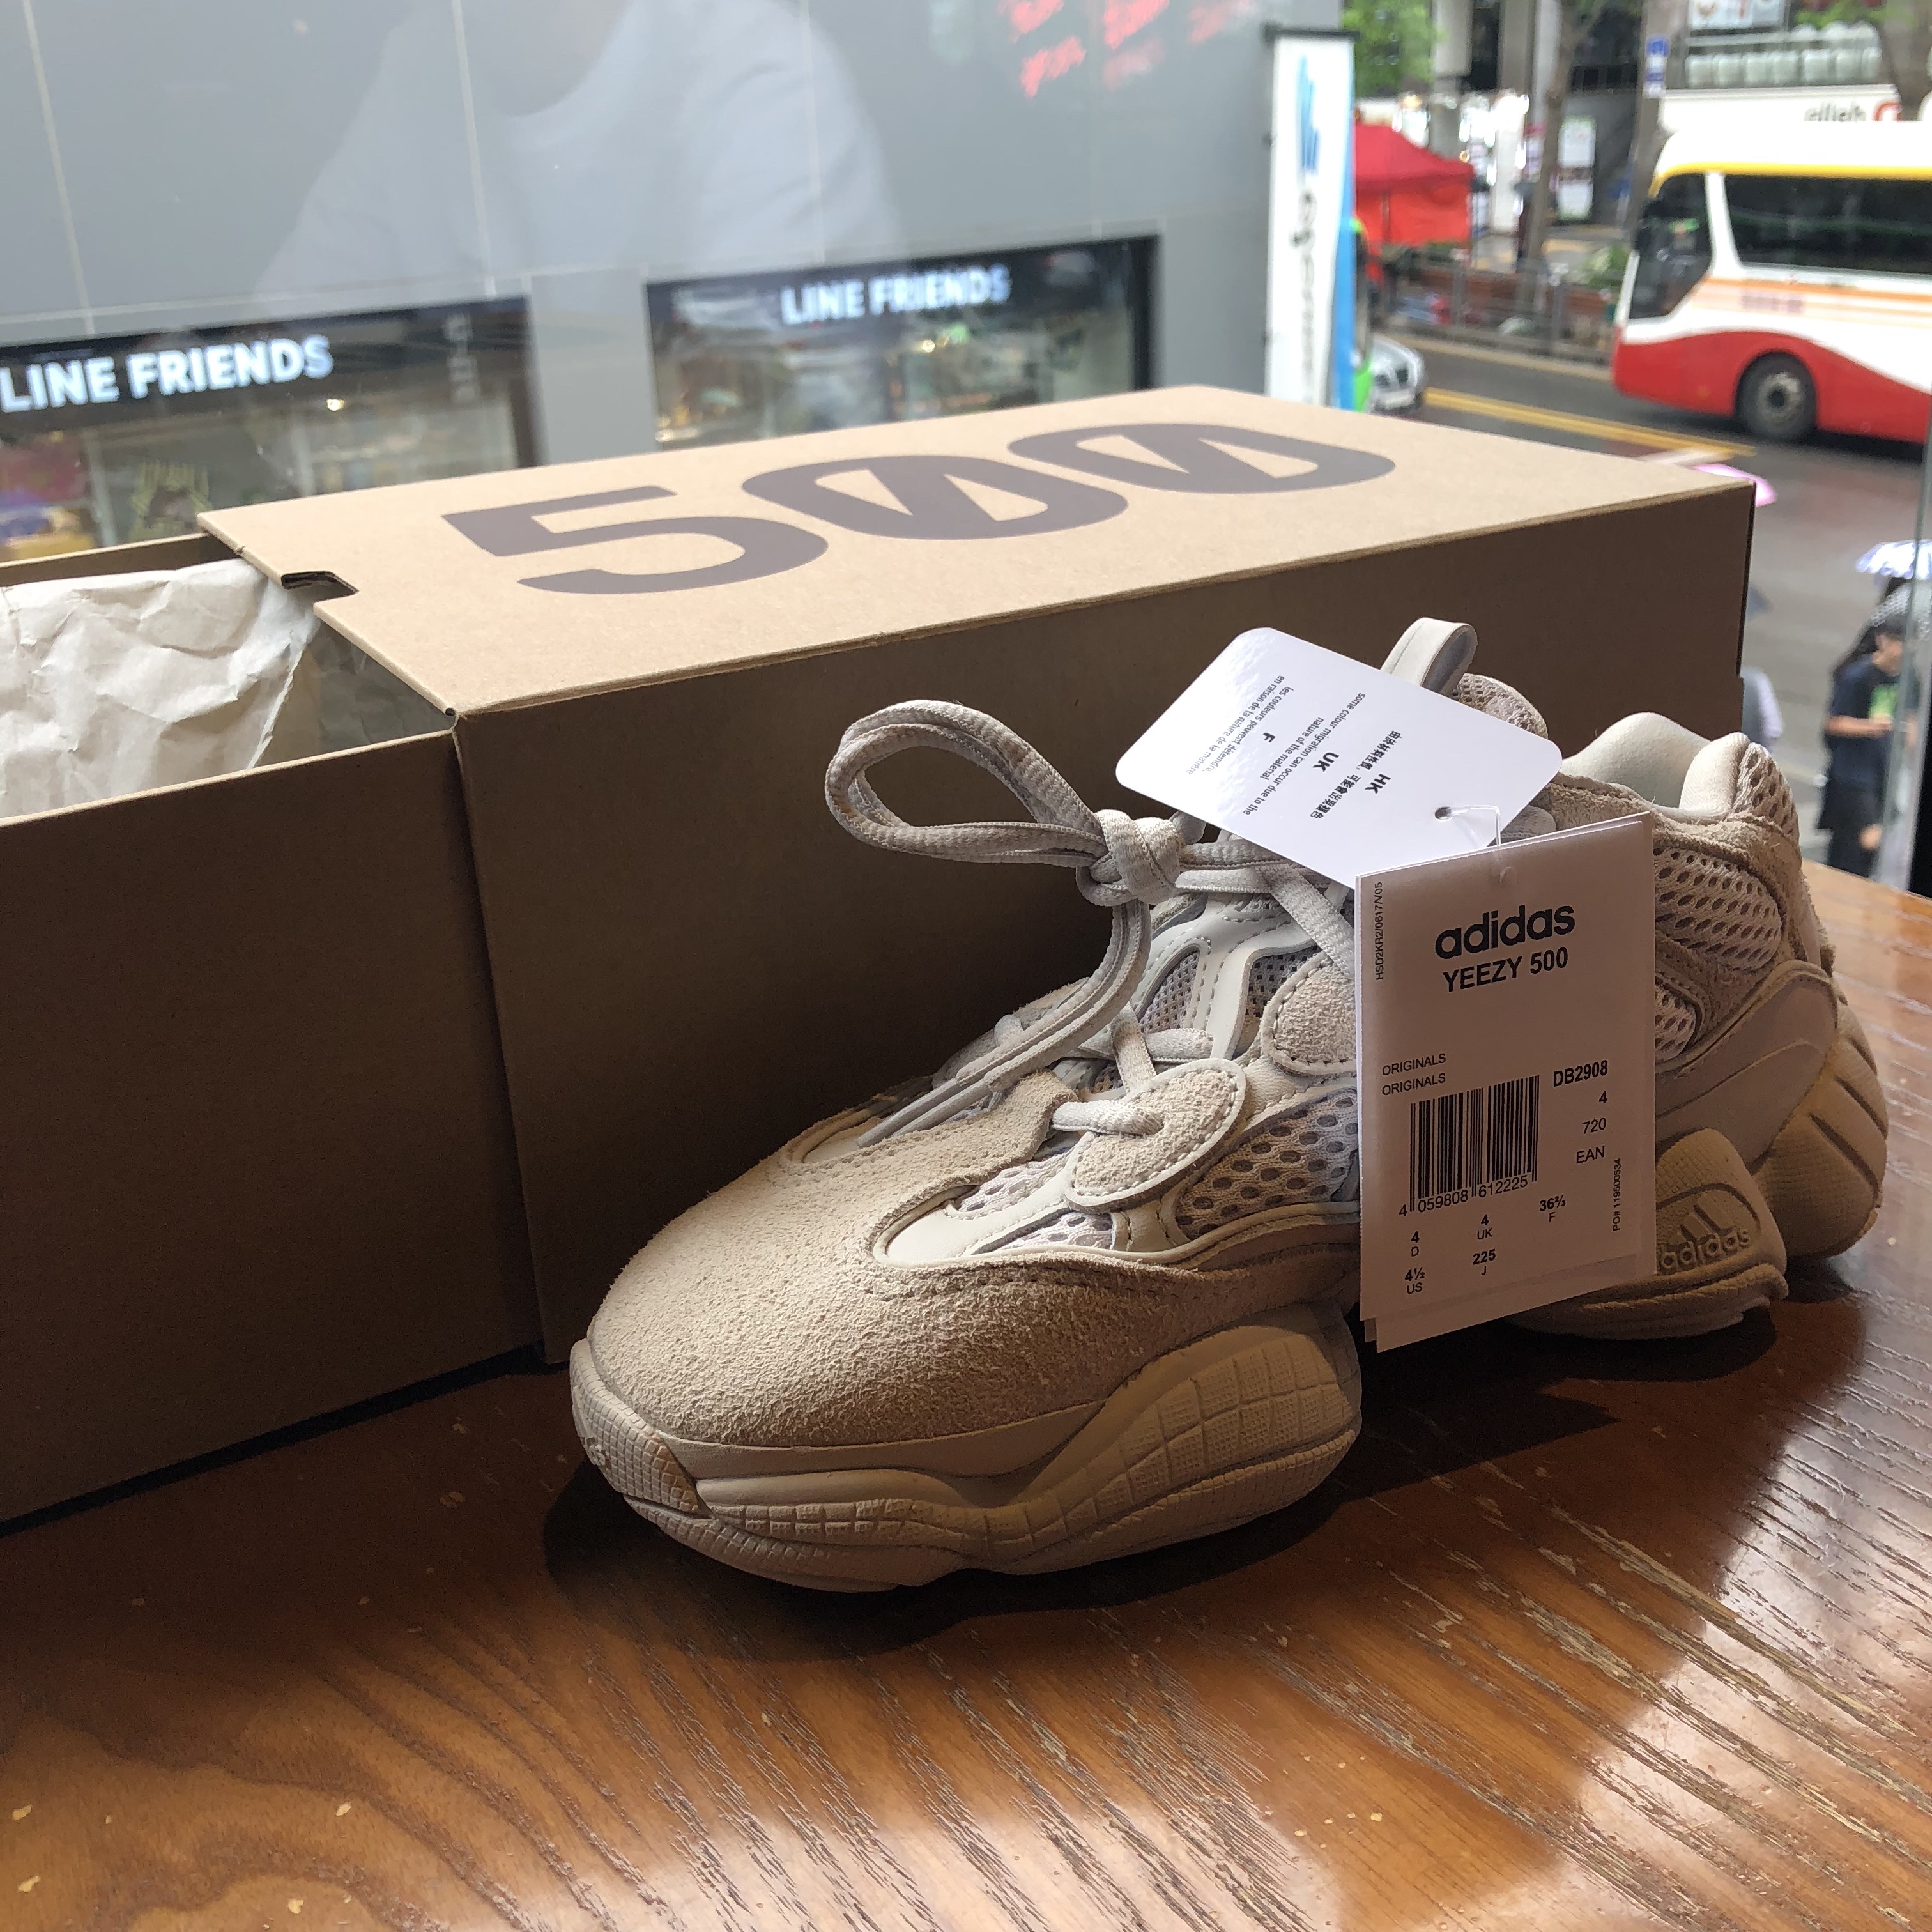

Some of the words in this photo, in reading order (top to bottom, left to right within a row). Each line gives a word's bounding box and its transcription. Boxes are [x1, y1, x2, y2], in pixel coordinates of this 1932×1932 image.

[782, 281, 864, 325] LINE
[871, 263, 1011, 315] FRIENDS
[0, 358, 119, 412] LINE
[127, 335, 334, 399] FRIENDS
[441, 424, 1395, 594] 500
[1274, 675, 1285, 684] en
[1256, 684, 1277, 702] raison
[1279, 687, 1294, 696] les
[1248, 702, 1260, 710] de
[1255, 696, 1282, 721] couleurs
[1347, 693, 1365, 709] some
[1302, 717, 1324, 737] nature
[1330, 710, 1349, 729] colour
[1232, 720, 1257, 745] peuvent
[1262, 732, 1277, 743] F
[1296, 737, 1305, 745] of
[1285, 744, 1300, 754] the
[1301, 728, 1331, 756] migration
[1260, 754, 1288, 780] material
[1289, 756, 1305, 767] can
[1313, 753, 1339, 772] UK
[1273, 768, 1292, 786] occur
[1365, 774, 1391, 793] HK
[1261, 785, 1276, 797] due
[1243, 804, 1259, 815] the
[1436, 905, 1575, 959] adidas
[1443, 956, 1522, 992] YEEZY
[1530, 947, 1568, 974] 500
[1383, 1054, 1446, 1075] ORIGINALS
[1554, 1060, 1607, 1087] DB2908
[1382, 1073, 1445, 1095] ORIGINALS
[1599, 1091, 1607, 1103] 4
[1583, 1118, 1606, 1134] 720
[1577, 1146, 1605, 1163] EAN
[1399, 1204, 1407, 1216] 4
[1418, 1190, 1469, 1213] 059808
[1478, 1176, 1528, 1198] 612225
[1481, 1214, 1489, 1226] 4
[1549, 1211, 1556, 1223] F
[1411, 1231, 1419, 1243] 4
[1478, 1228, 1492, 1239] UK
[1411, 1246, 1419, 1257] D
[1473, 1249, 1496, 1265] 225
[1660, 1228, 1751, 1269] adidas
[1481, 1265, 1487, 1276] J
[1407, 1282, 1422, 1294] US
